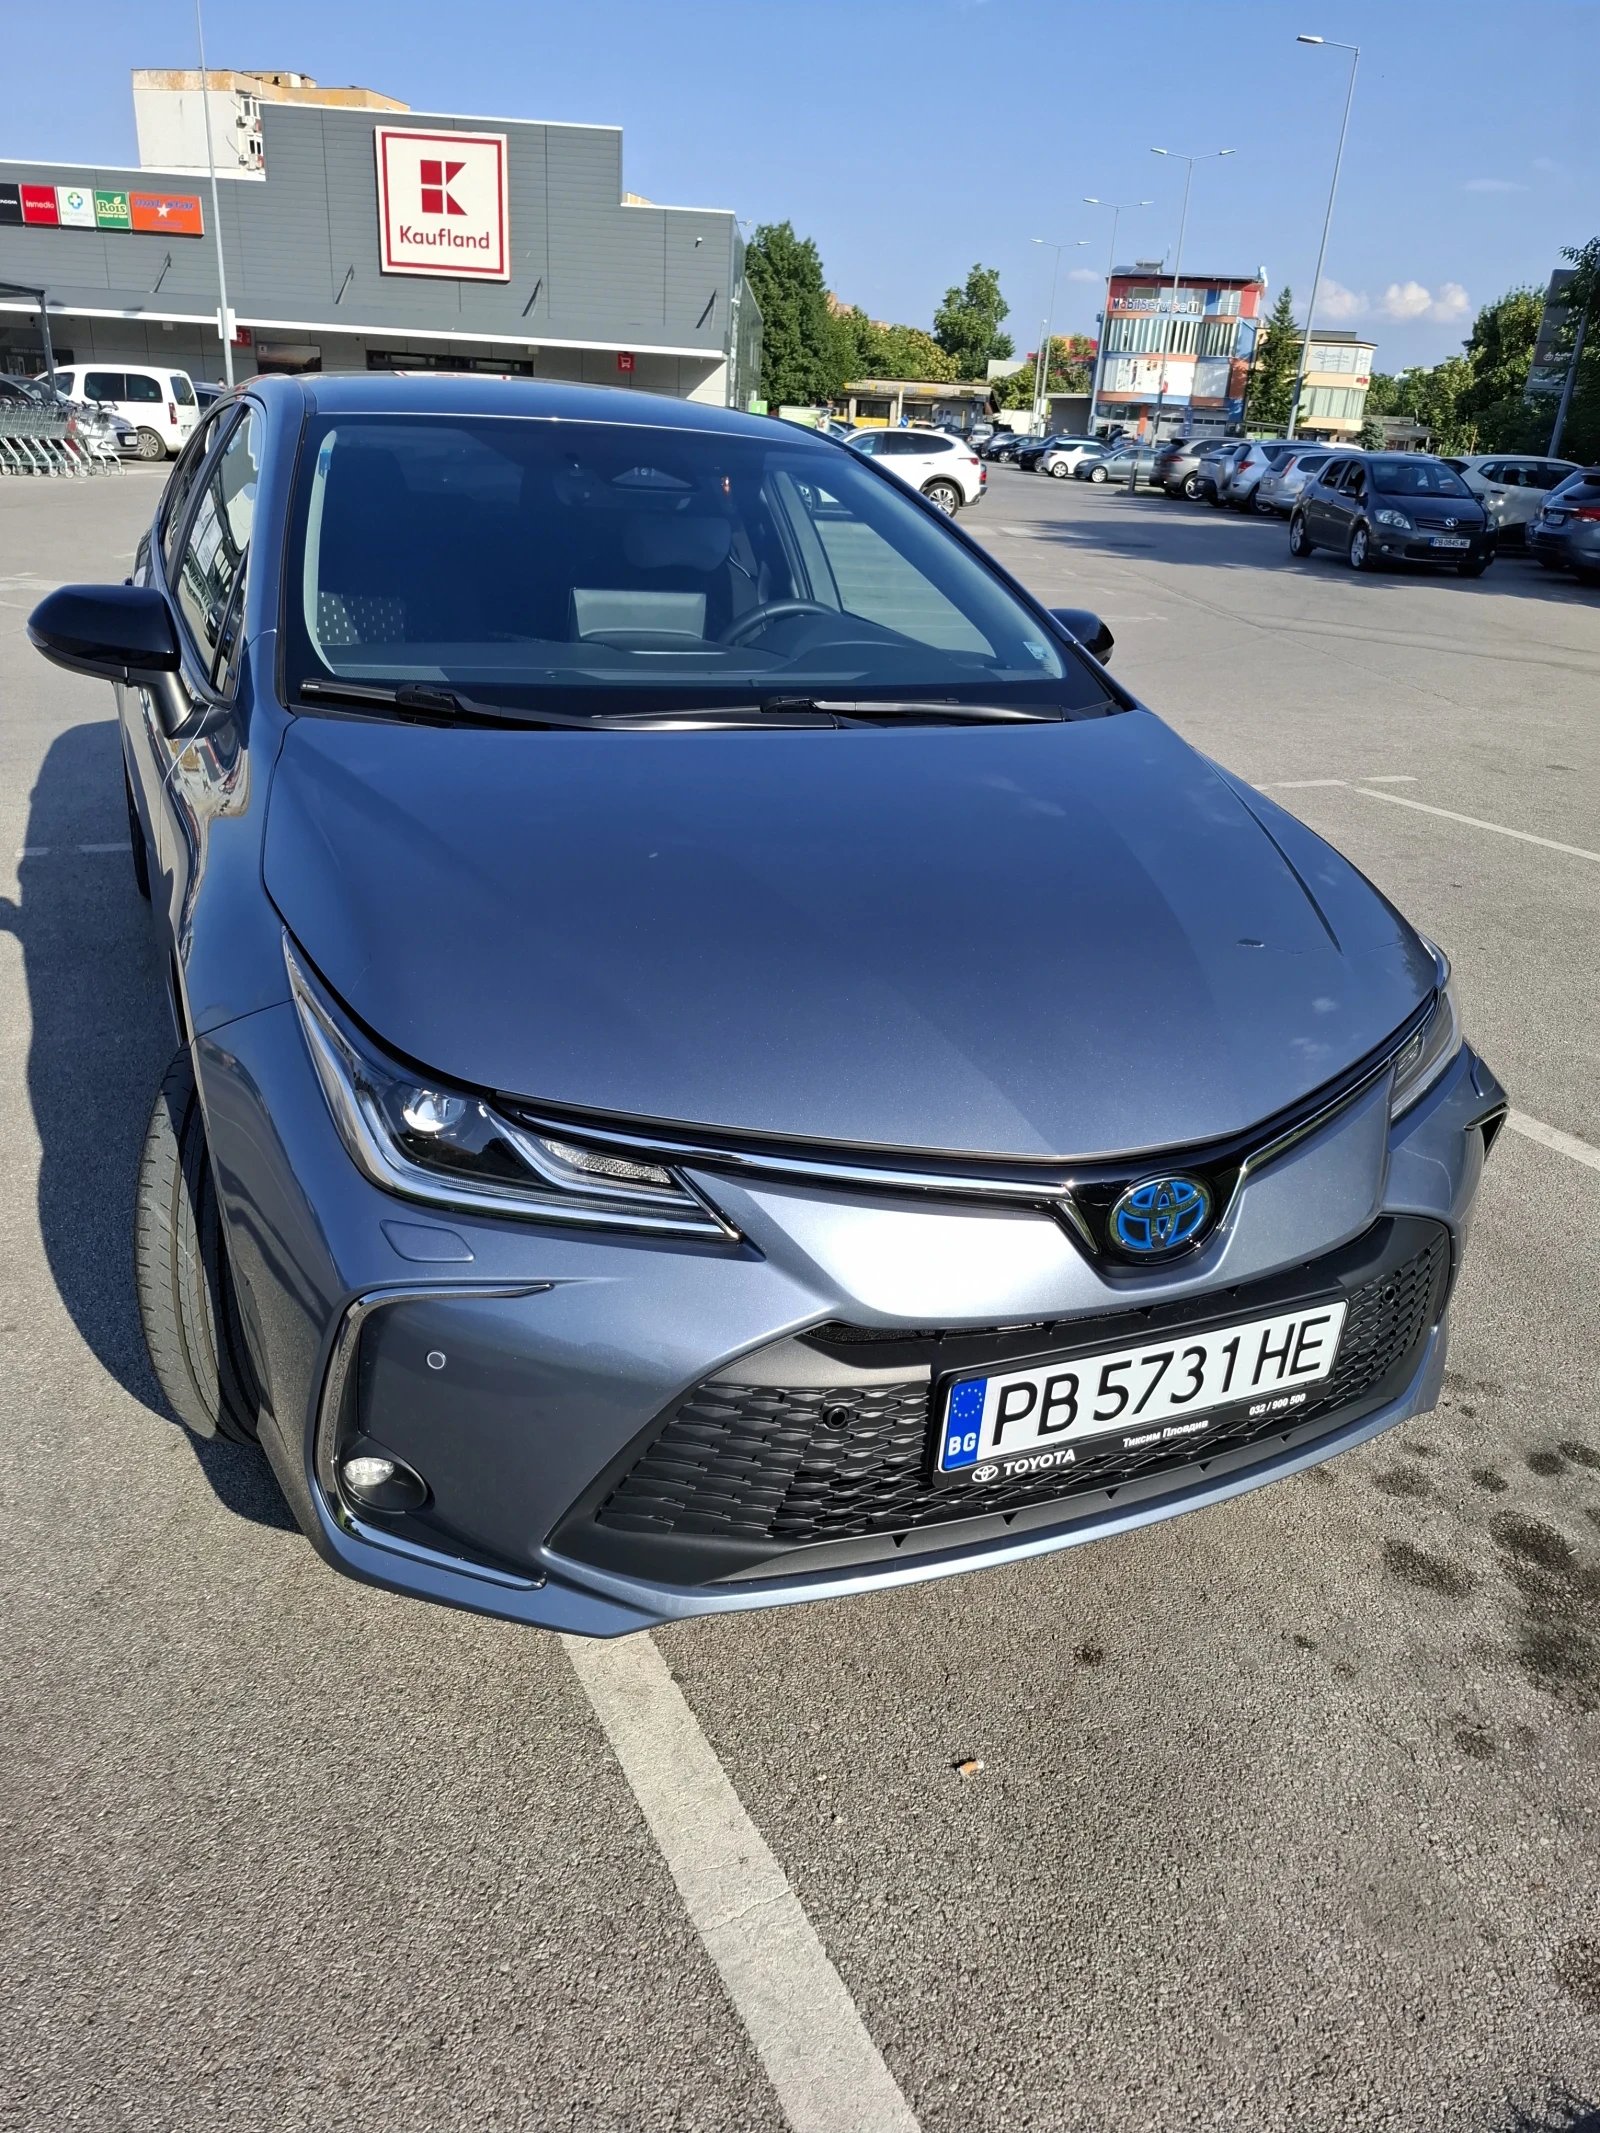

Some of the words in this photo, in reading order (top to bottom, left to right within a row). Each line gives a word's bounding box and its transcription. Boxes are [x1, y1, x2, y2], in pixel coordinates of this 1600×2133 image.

[98, 201, 126, 214] Rois
[400, 225, 490, 250] Kaufland
[992, 1373, 1080, 1446] PB
[1093, 1336, 1242, 1421] 5731
[1251, 1314, 1331, 1385] HE
[1249, 1404, 1265, 1416] 032
[1272, 1399, 1288, 1411] 900
[1289, 1393, 1307, 1405] 500
[948, 1432, 976, 1456] BG
[1122, 1430, 1161, 1448] Тиксим
[1162, 1420, 1209, 1438] Пловдив
[1003, 1449, 1076, 1476] TOYOTA
